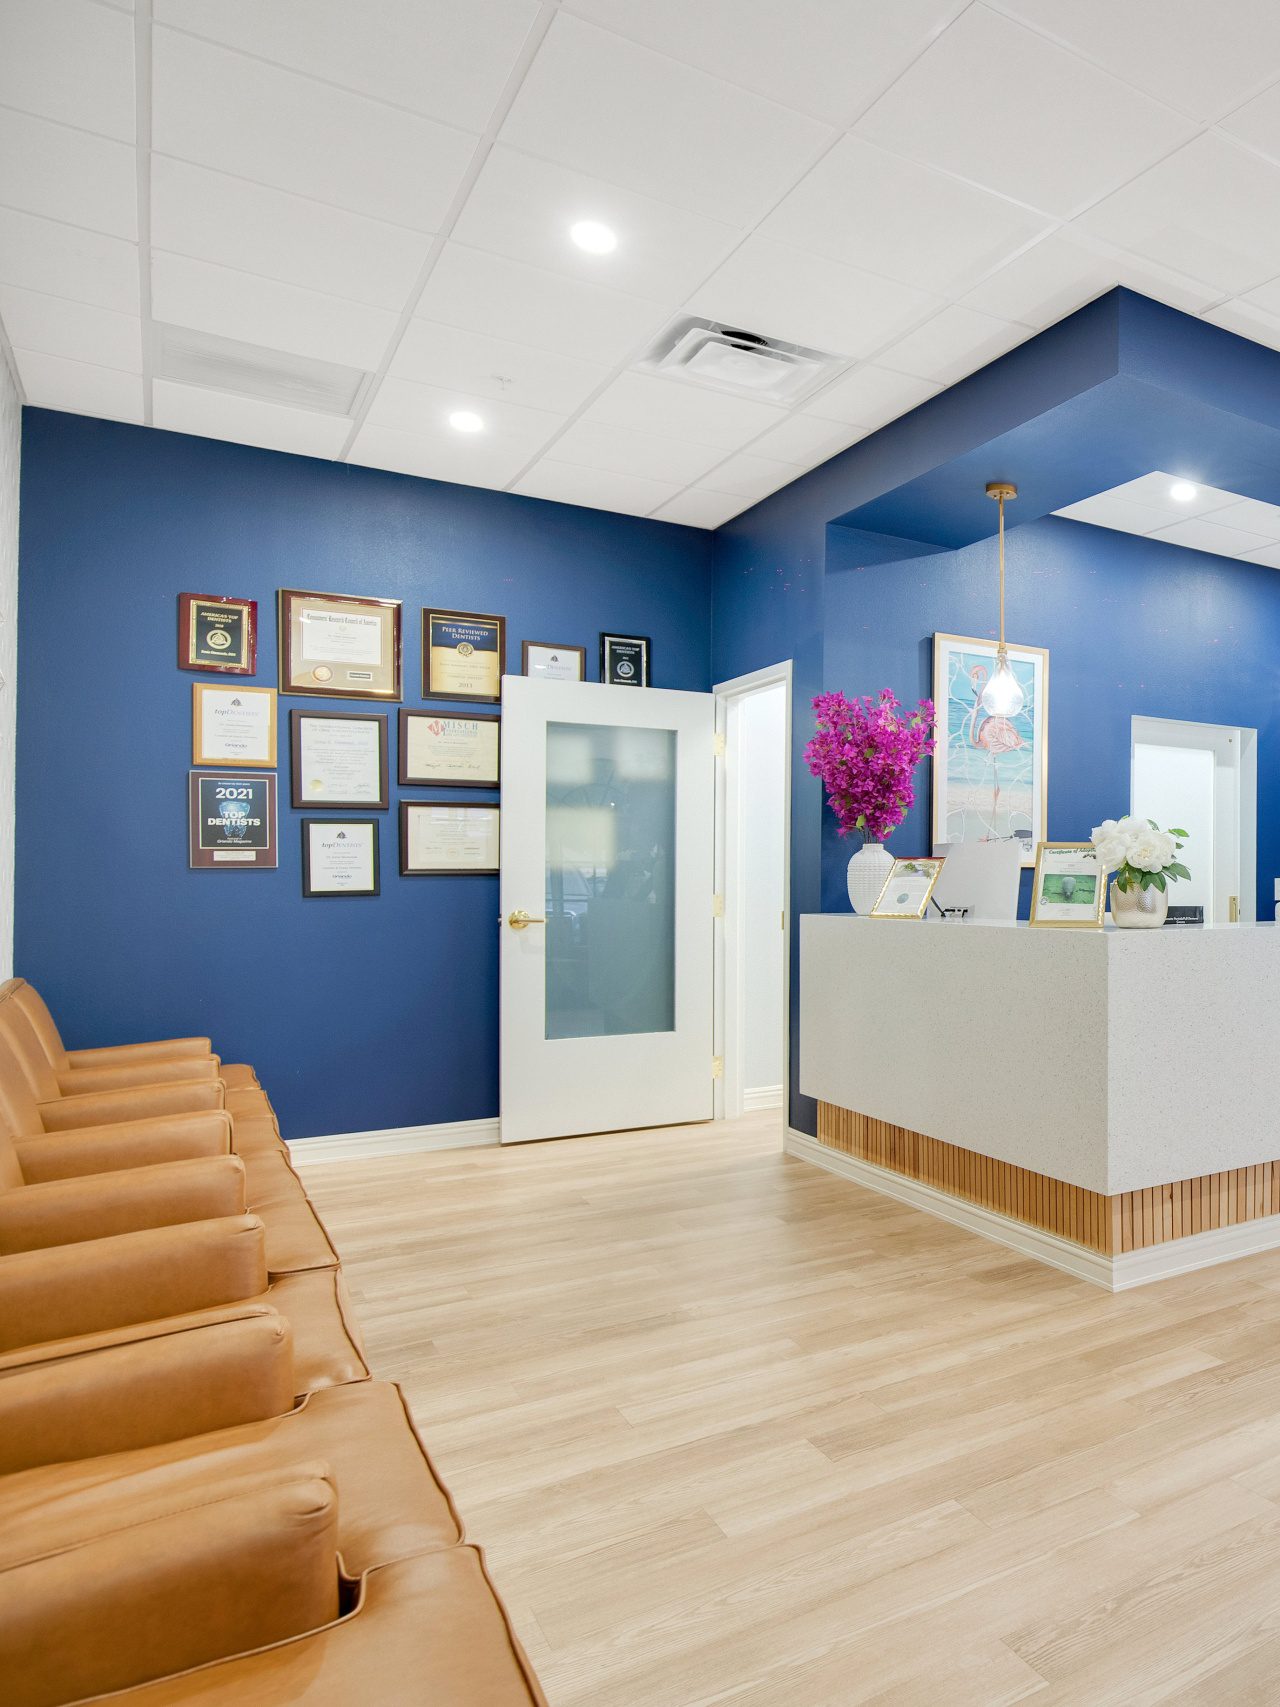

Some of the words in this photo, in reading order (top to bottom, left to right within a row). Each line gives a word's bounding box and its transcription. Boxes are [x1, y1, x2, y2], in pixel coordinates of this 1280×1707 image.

[458, 628, 489, 636] REVIEWED
[215, 787, 253, 799] 2021
[223, 811, 245, 819] TOP
[207, 818, 261, 826] DENTISTS
